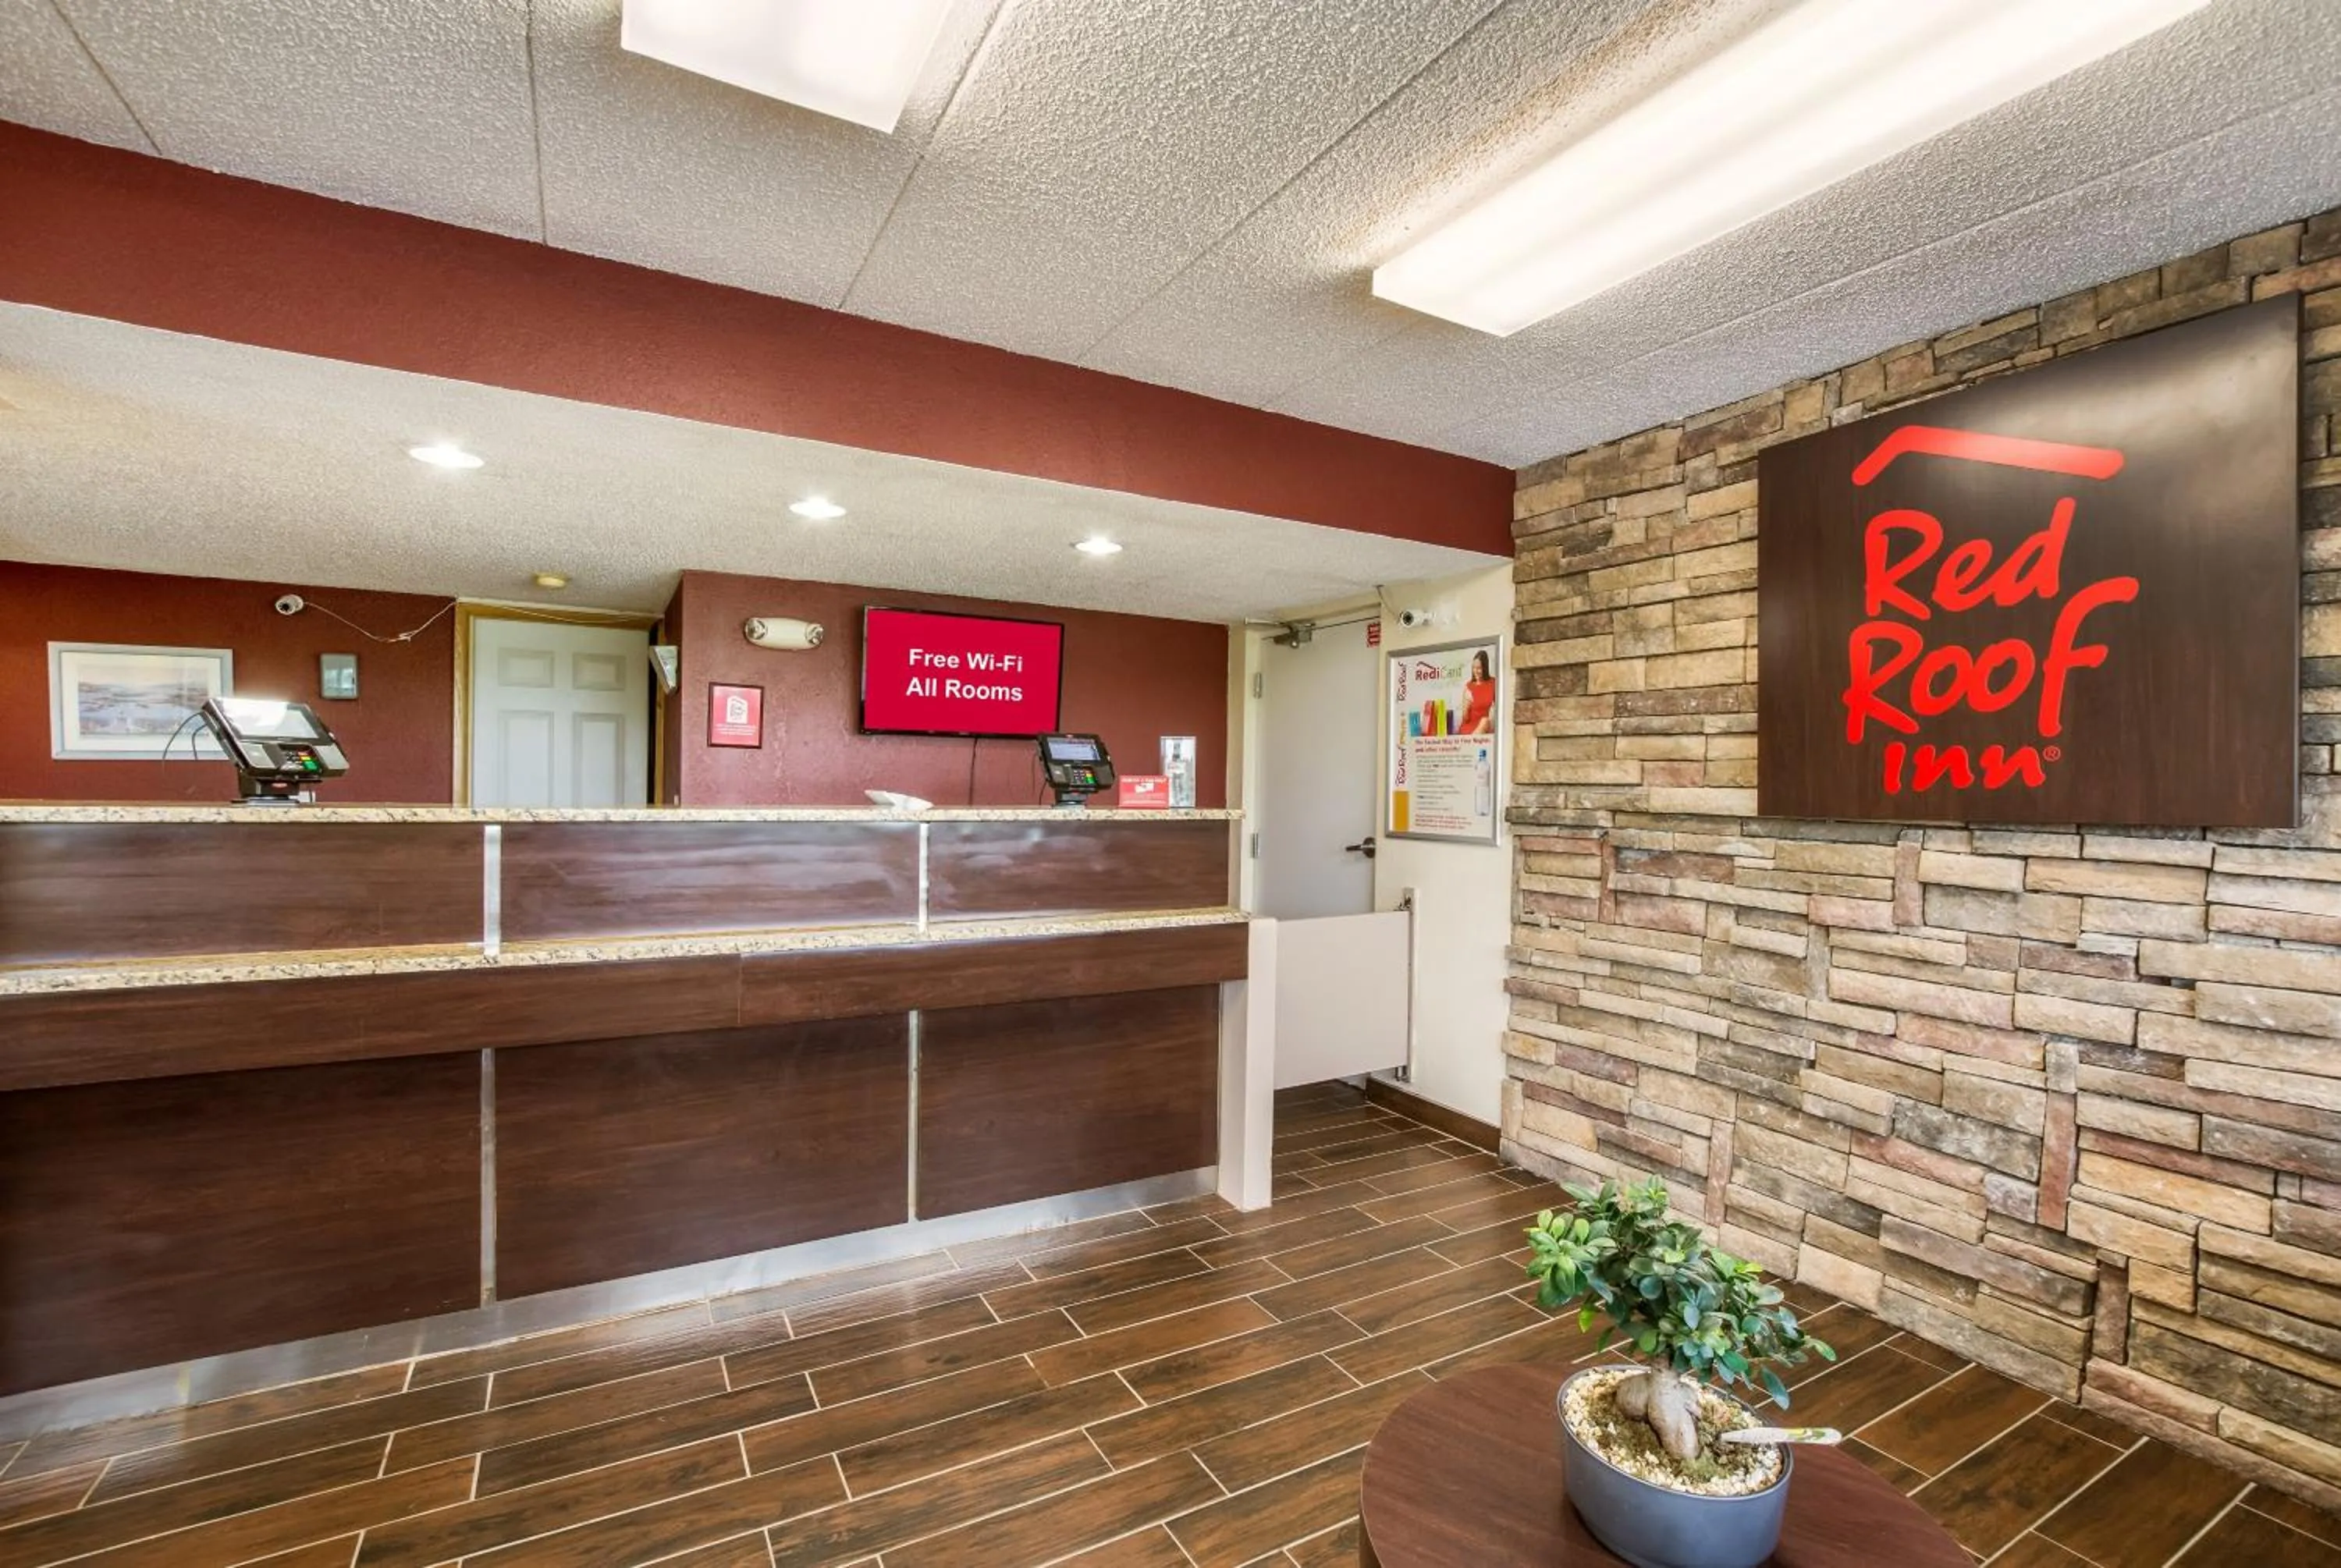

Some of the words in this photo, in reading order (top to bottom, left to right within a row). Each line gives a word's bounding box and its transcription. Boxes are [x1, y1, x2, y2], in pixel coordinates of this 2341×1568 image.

[1864, 497, 2076, 620] Red
[906, 676, 937, 697] All
[945, 679, 1023, 701] Rooms
[908, 648, 960, 669] Free
[967, 652, 1023, 672] Wi-Fi
[1842, 576, 2139, 745] Roof
